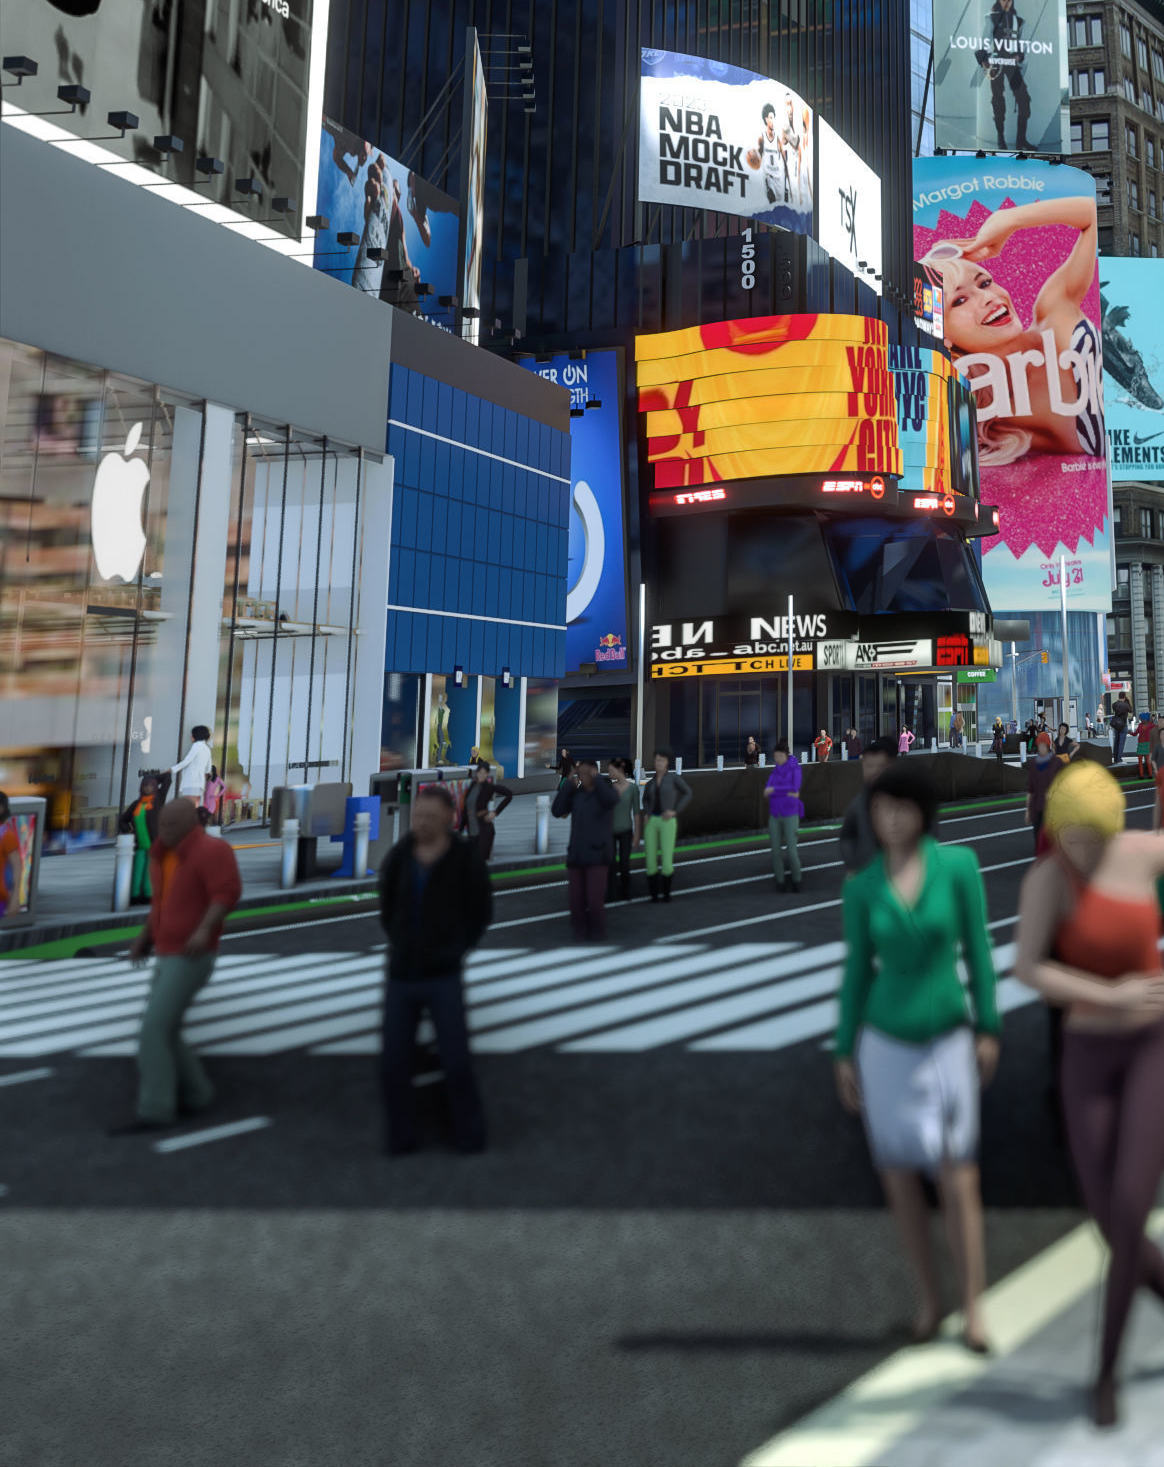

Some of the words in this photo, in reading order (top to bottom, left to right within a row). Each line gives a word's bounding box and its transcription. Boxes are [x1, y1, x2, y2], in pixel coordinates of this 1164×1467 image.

[949, 35, 991, 51] LOUIS
[994, 38, 1053, 54] VUITTON
[659, 106, 723, 141] NBA
[659, 132, 744, 172] MOCK
[659, 159, 750, 198] DRAFT
[912, 178, 979, 211] Margot
[983, 174, 1046, 192] Robbie
[838, 185, 858, 258] TSX
[741, 227, 756, 290] 1500
[821, 480, 864, 492] ESPN
[750, 614, 827, 641] NEWS
[595, 648, 610, 662] Red
[610, 647, 626, 660] Bull
